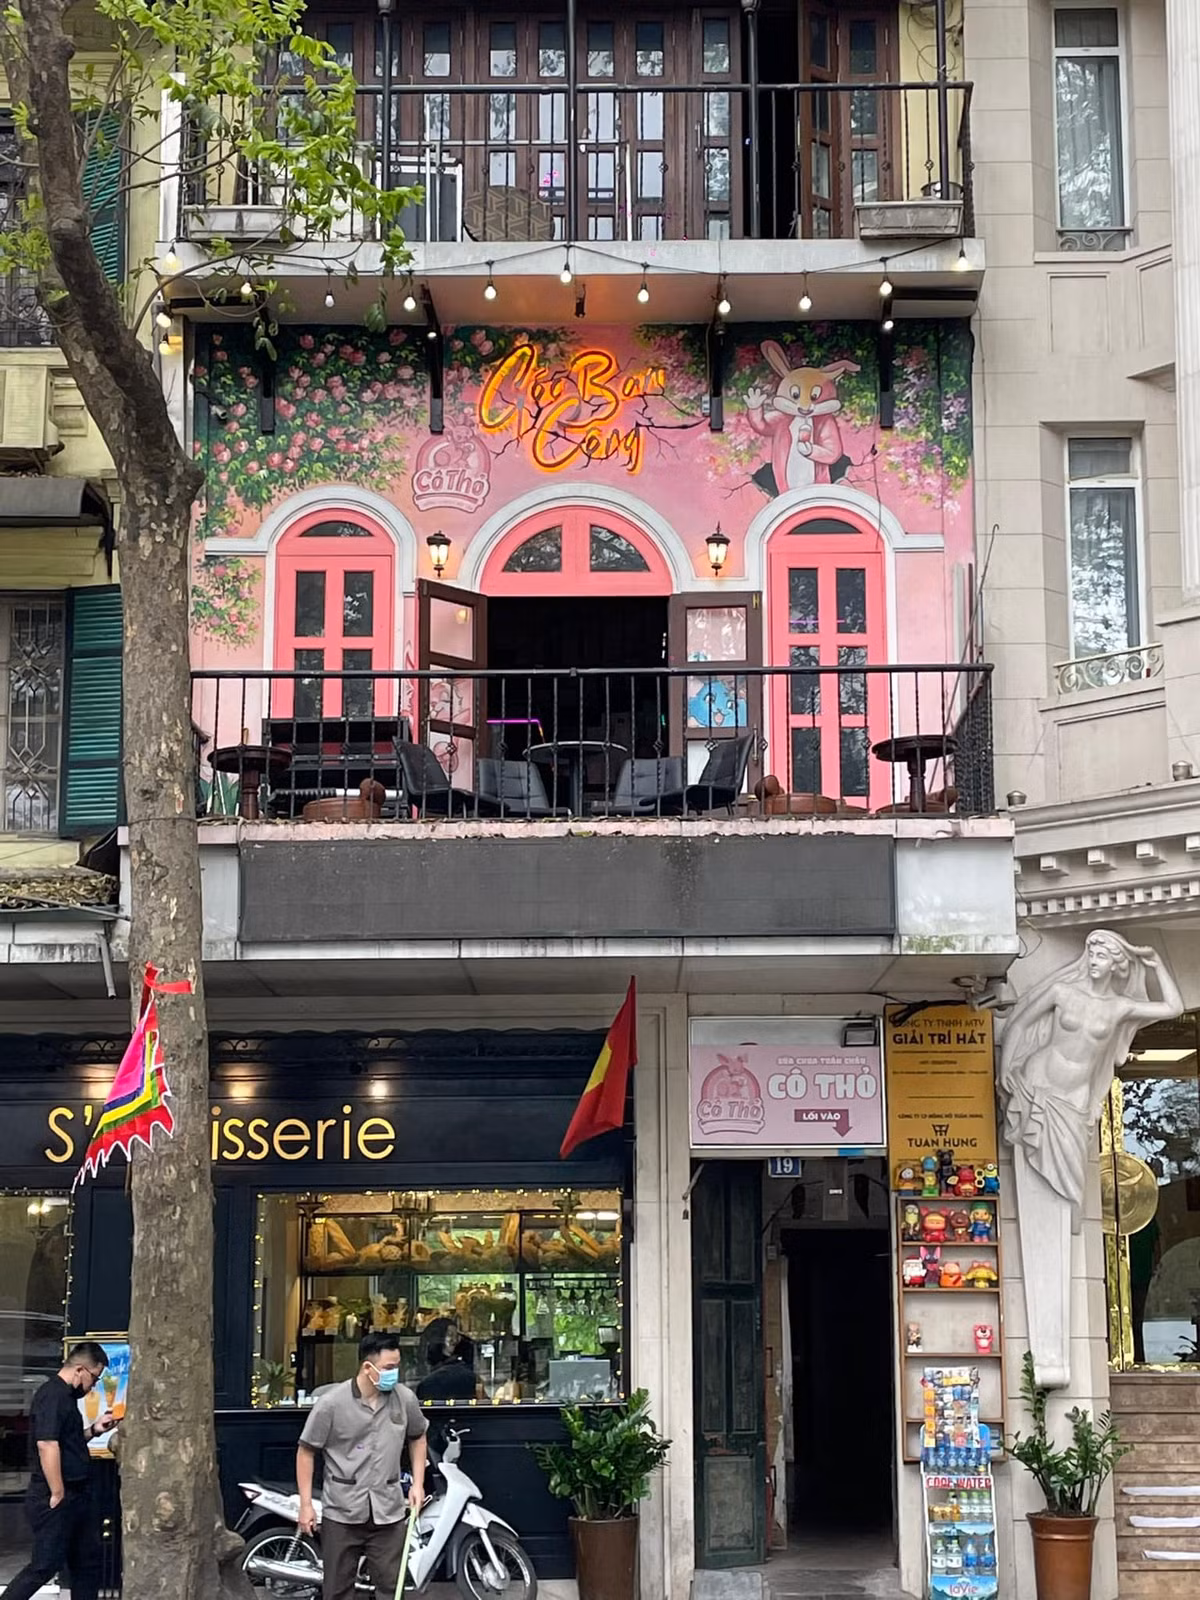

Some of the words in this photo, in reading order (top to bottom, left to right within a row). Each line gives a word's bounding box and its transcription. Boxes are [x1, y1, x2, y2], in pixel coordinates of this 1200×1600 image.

[558, 349, 666, 428] Ban
[416, 470, 443, 492] Cô
[893, 1029, 924, 1044] GIẢI
[928, 1029, 952, 1044] TRÍ
[956, 1029, 986, 1044] HÁT
[768, 1067, 808, 1100] CÔ
[814, 1065, 877, 1100] THỎ
[820, 1110, 841, 1120] VÀO
[908, 1138, 939, 1147] TUAN
[943, 1138, 977, 1147] HUNG
[775, 1157, 793, 1174] 19
